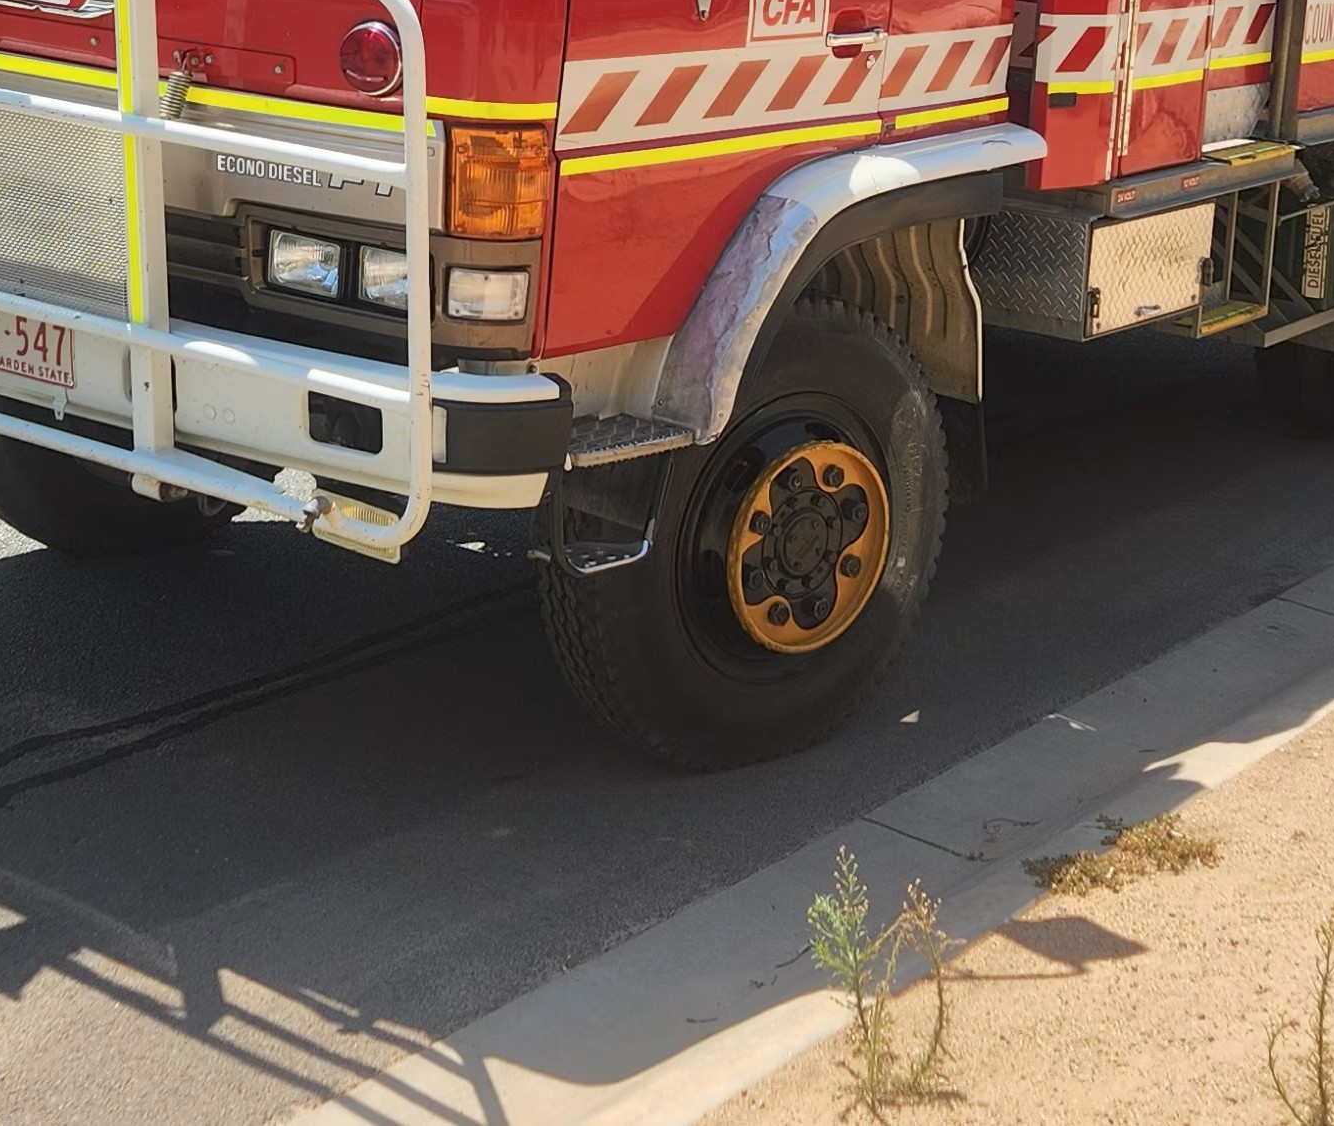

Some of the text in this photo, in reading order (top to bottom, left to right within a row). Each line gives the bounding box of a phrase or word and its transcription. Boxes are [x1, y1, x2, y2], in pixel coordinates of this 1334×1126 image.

[217, 154, 265, 178] ECONO
[268, 164, 322, 187] DIESEL
[38, 366, 70, 384] STATE
